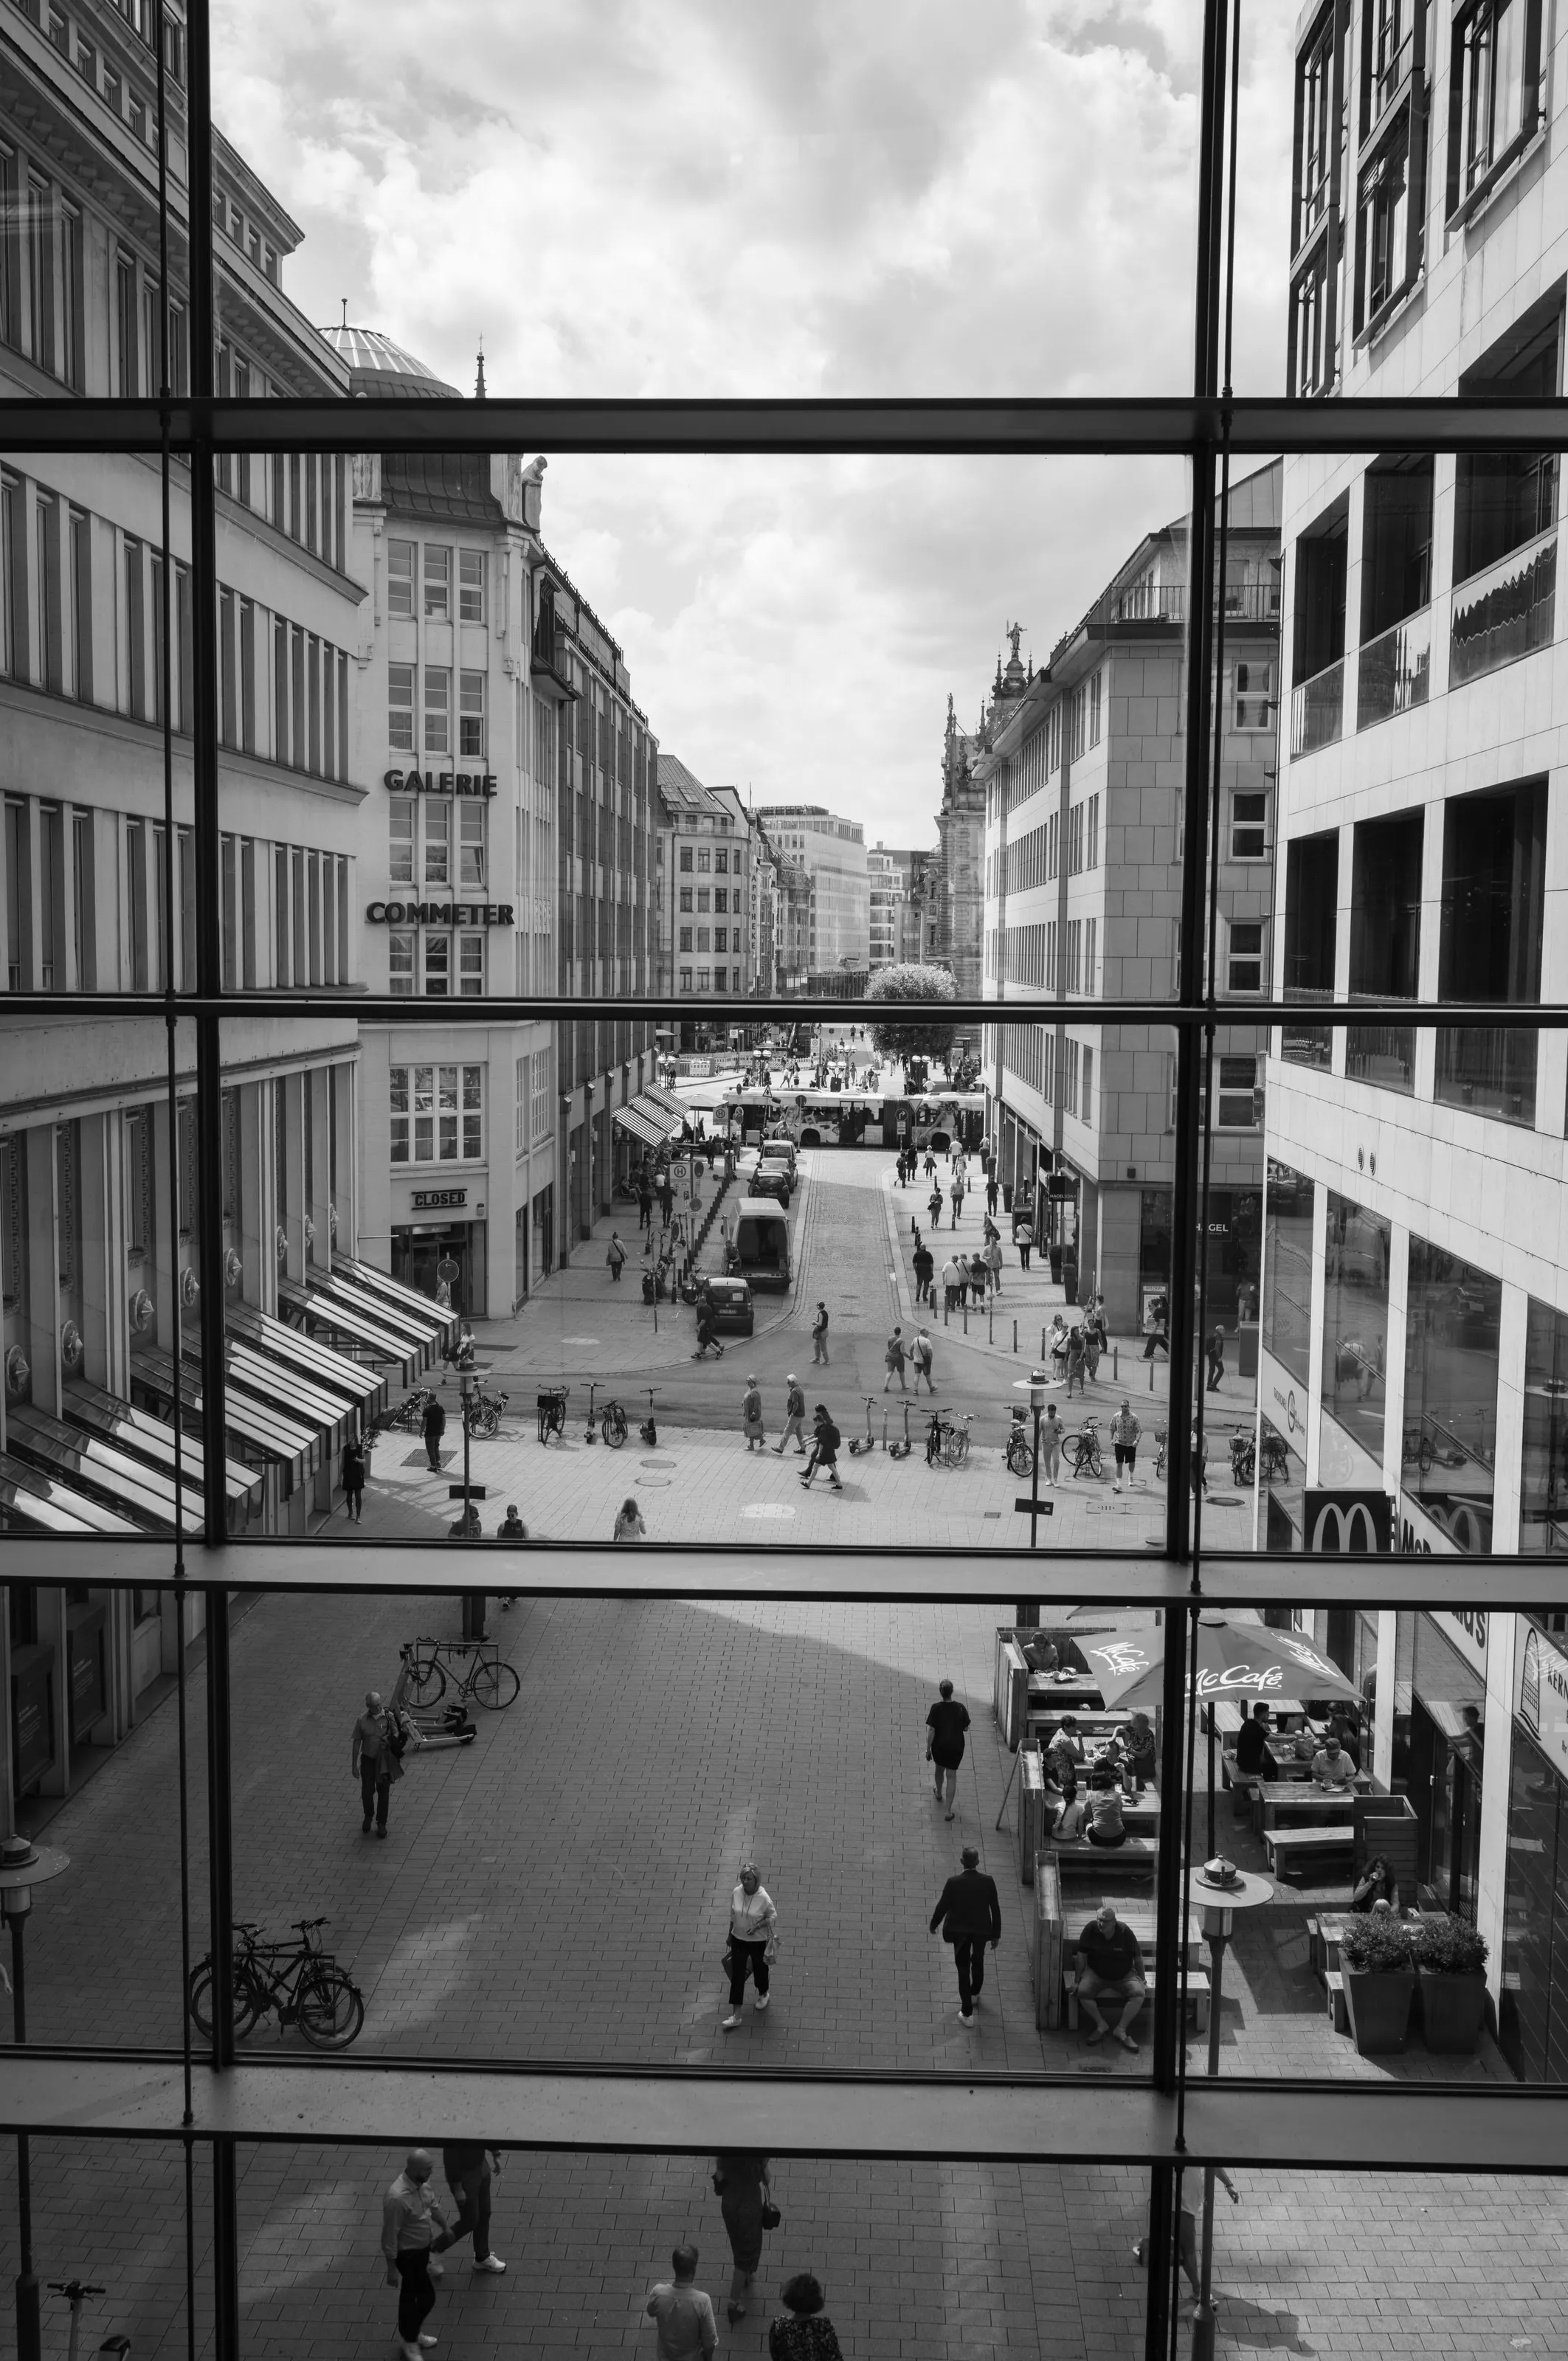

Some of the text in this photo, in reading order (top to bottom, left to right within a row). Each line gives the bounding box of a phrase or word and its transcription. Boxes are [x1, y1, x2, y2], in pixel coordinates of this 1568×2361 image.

[384, 770, 497, 796] GALERIE
[366, 902, 515, 924] COMMETER
[415, 1192, 466, 1206] CLOSED
[1195, 1223, 1229, 1232] HGEL
[1089, 1642, 1150, 1677] McCafé
[1185, 1665, 1284, 1696] McCafé
